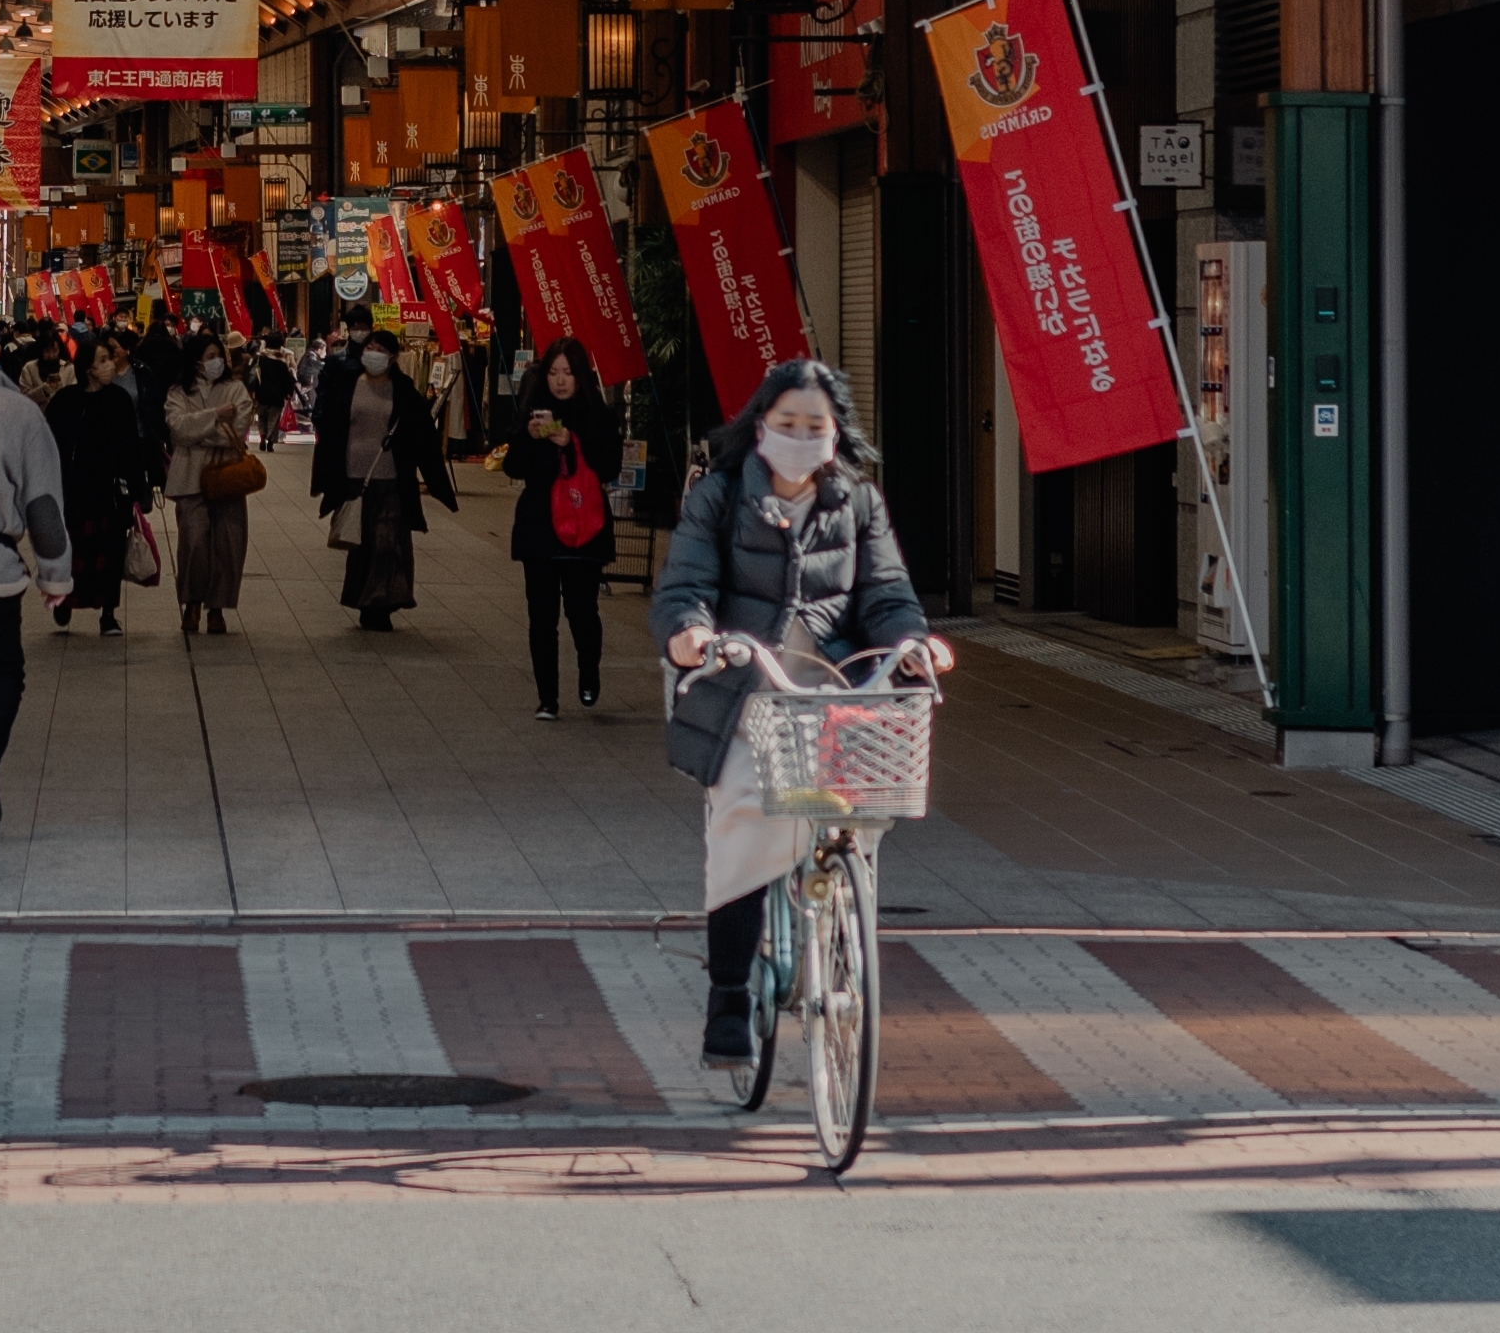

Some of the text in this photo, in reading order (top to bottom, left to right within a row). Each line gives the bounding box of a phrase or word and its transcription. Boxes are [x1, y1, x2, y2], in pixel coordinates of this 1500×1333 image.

[88, 10, 219, 28] 応援しています
[87, 70, 223, 87] 東仁王門通商店街
[1147, 151, 1194, 167] bagel
